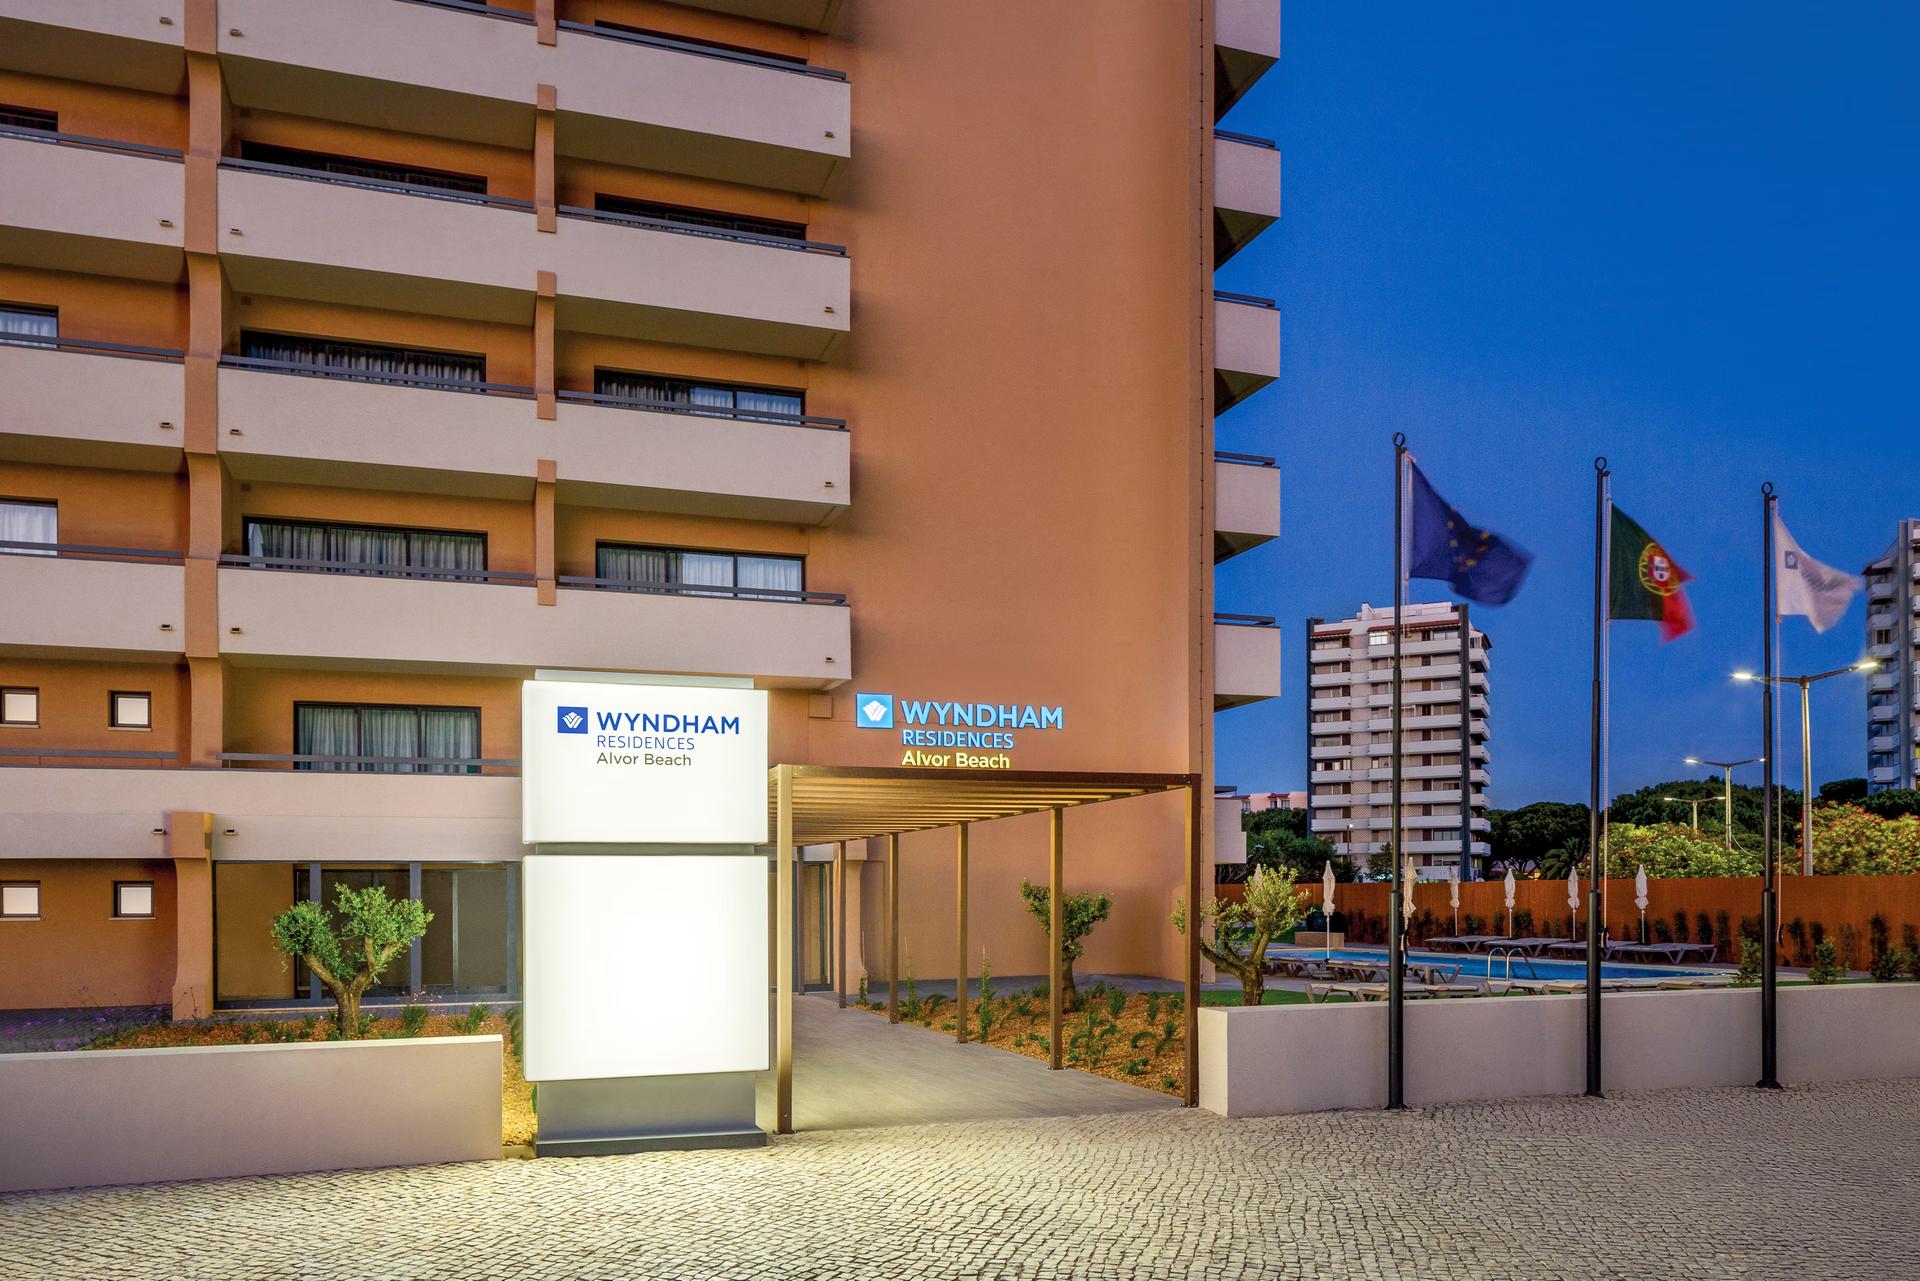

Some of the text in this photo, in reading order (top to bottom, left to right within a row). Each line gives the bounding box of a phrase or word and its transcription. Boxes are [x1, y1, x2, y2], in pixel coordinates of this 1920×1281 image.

[596, 711, 740, 735] WYNDHAM
[901, 700, 1064, 730] WYNDHAM
[597, 735, 695, 750] RESIDENCES
[902, 729, 1015, 749] RESIDENCES
[596, 752, 692, 767] Alvor Beach
[901, 750, 1010, 769] Alvor Beach
